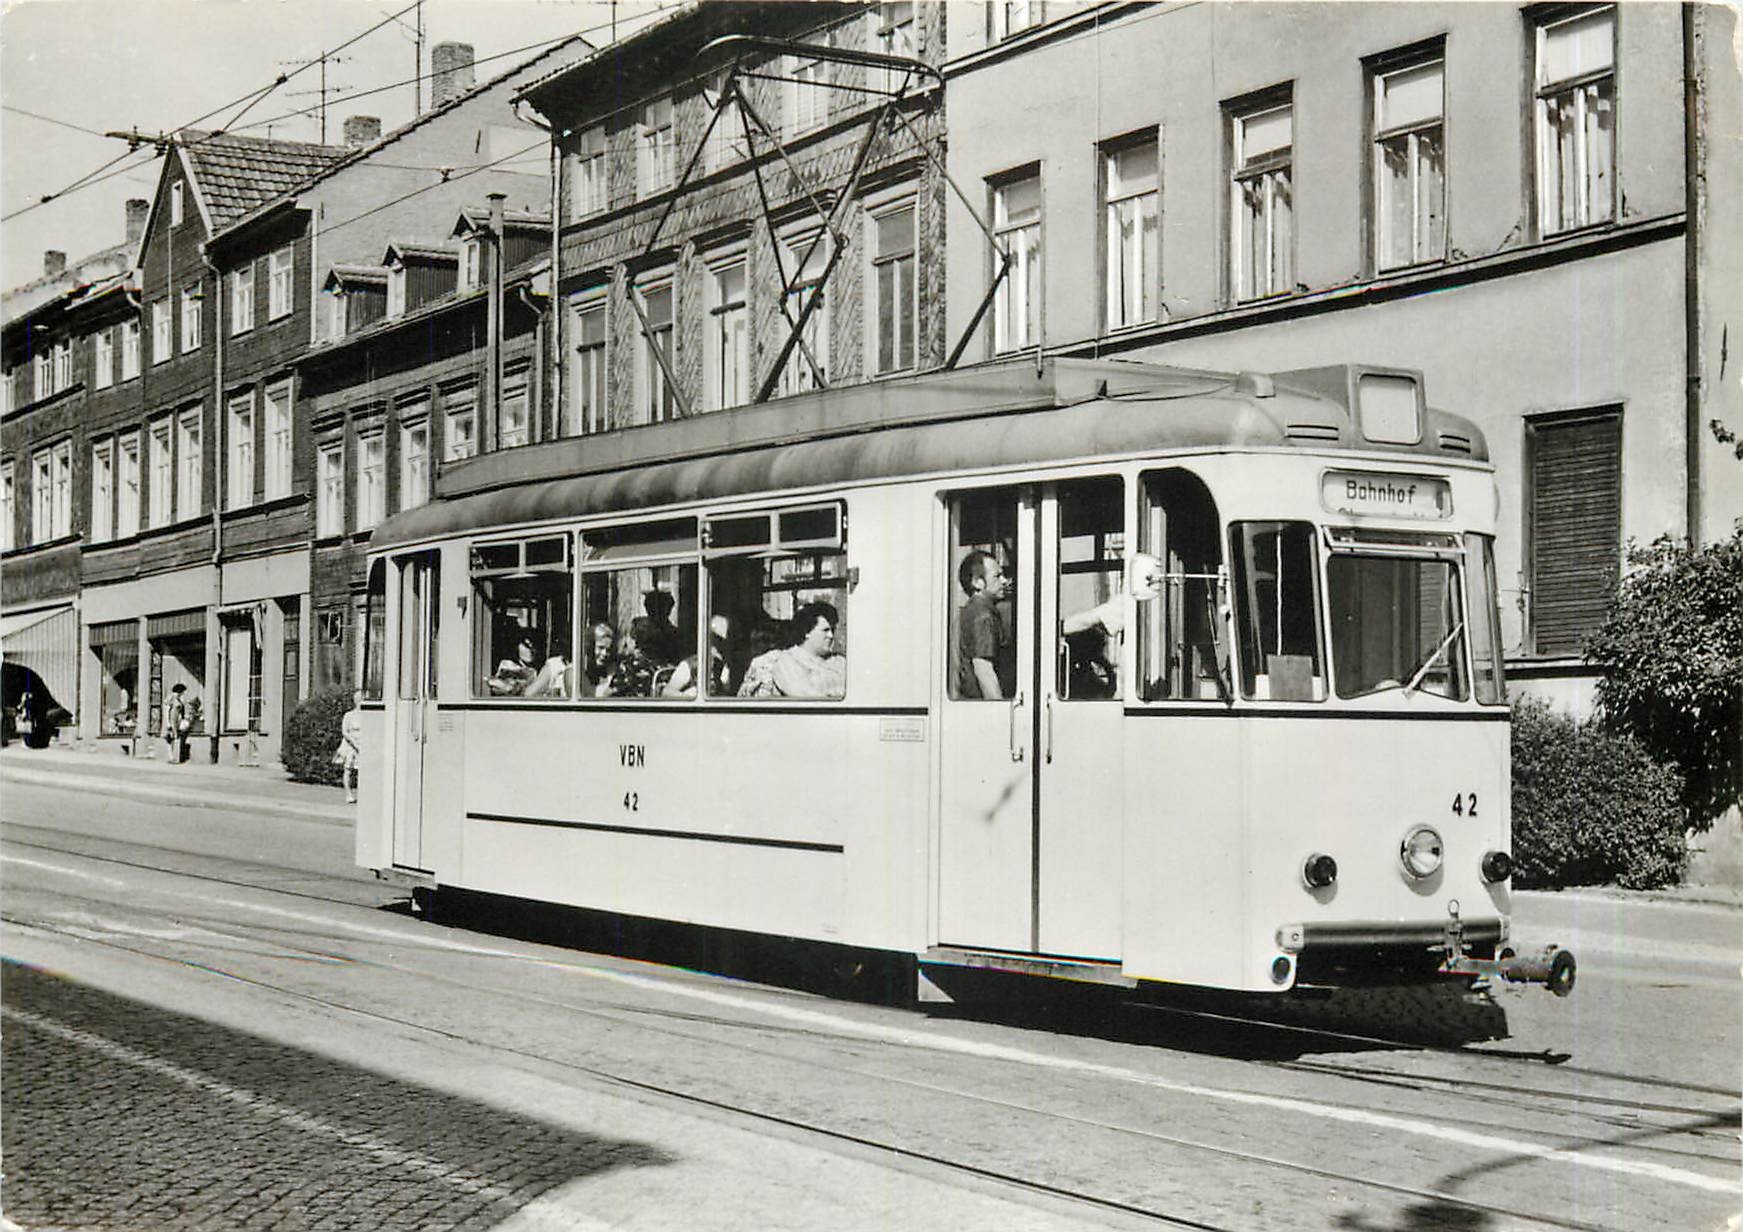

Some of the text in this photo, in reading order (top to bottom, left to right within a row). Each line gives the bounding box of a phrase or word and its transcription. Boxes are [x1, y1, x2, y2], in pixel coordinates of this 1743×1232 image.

[1346, 479, 1416, 504] Bahnhof
[620, 745, 645, 767] VBN
[623, 792, 638, 811] 42
[1452, 792, 1477, 816] 42
